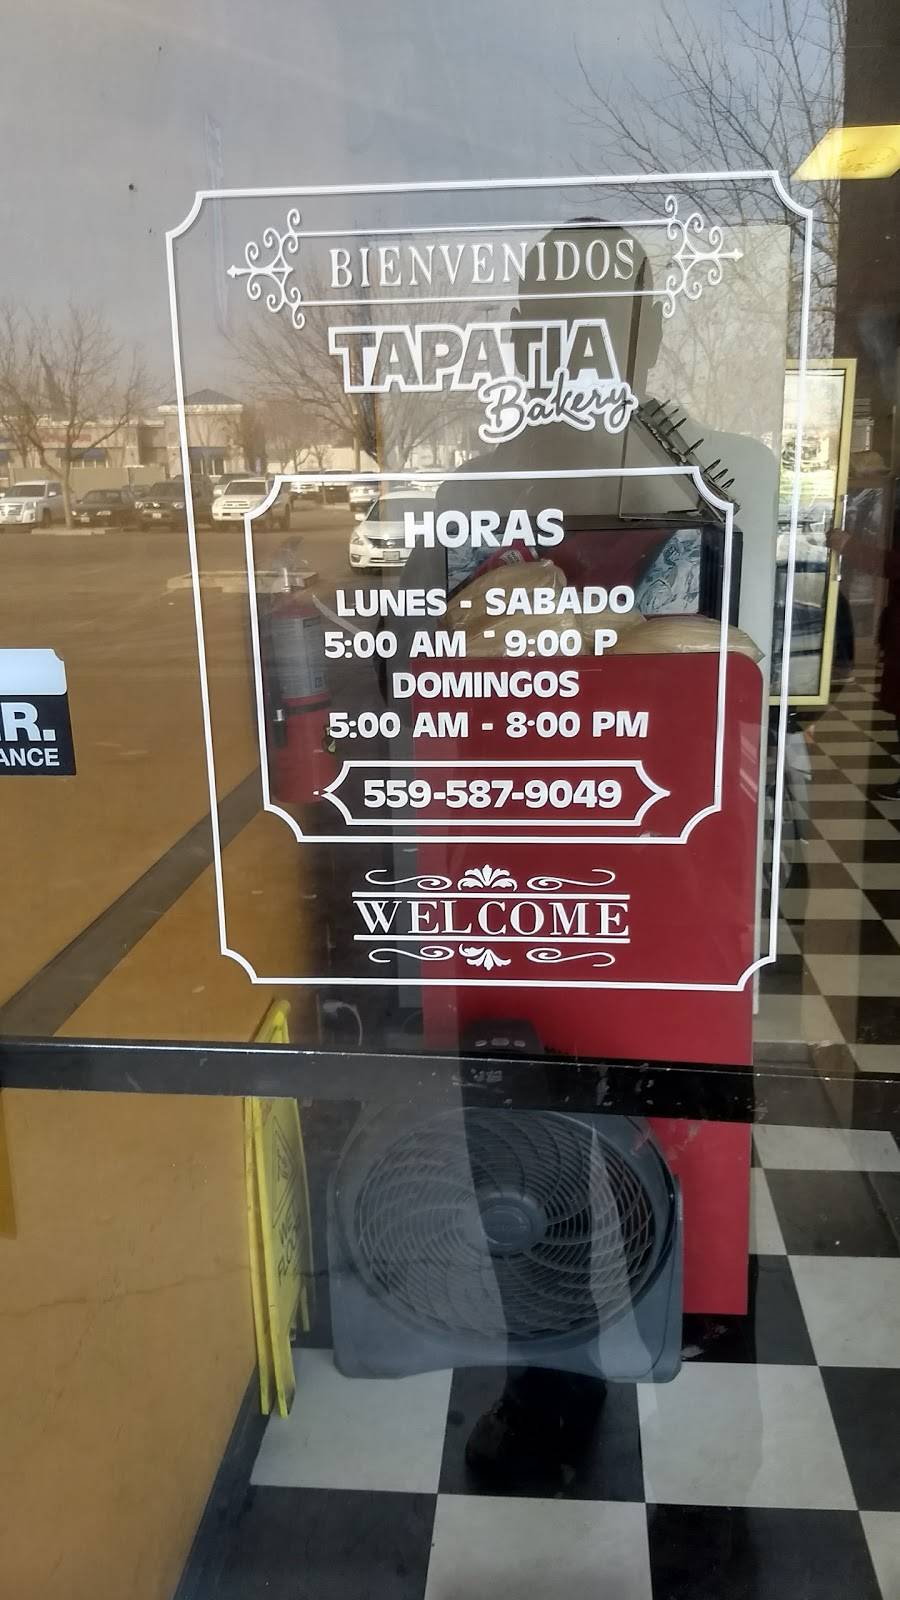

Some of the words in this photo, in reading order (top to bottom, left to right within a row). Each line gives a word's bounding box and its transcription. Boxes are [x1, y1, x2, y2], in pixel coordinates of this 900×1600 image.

[329, 239, 635, 289] BIENVENIDOS
[328, 319, 622, 393] TAPATIA
[478, 367, 639, 444] Bakery
[404, 508, 565, 549] HORAS
[335, 588, 448, 617] LUNES
[485, 585, 636, 615] SABADO
[324, 631, 398, 659] 5:00
[409, 631, 466, 658] AM
[504, 629, 582, 657] 9:00
[594, 628, 618, 656] P
[392, 671, 580, 698] DOMINGOS
[329, 711, 401, 739] 5:00
[412, 711, 469, 738] AM
[592, 710, 649, 738] PM
[363, 779, 622, 809] 559-587-9049
[353, 900, 630, 936] WELCOME
